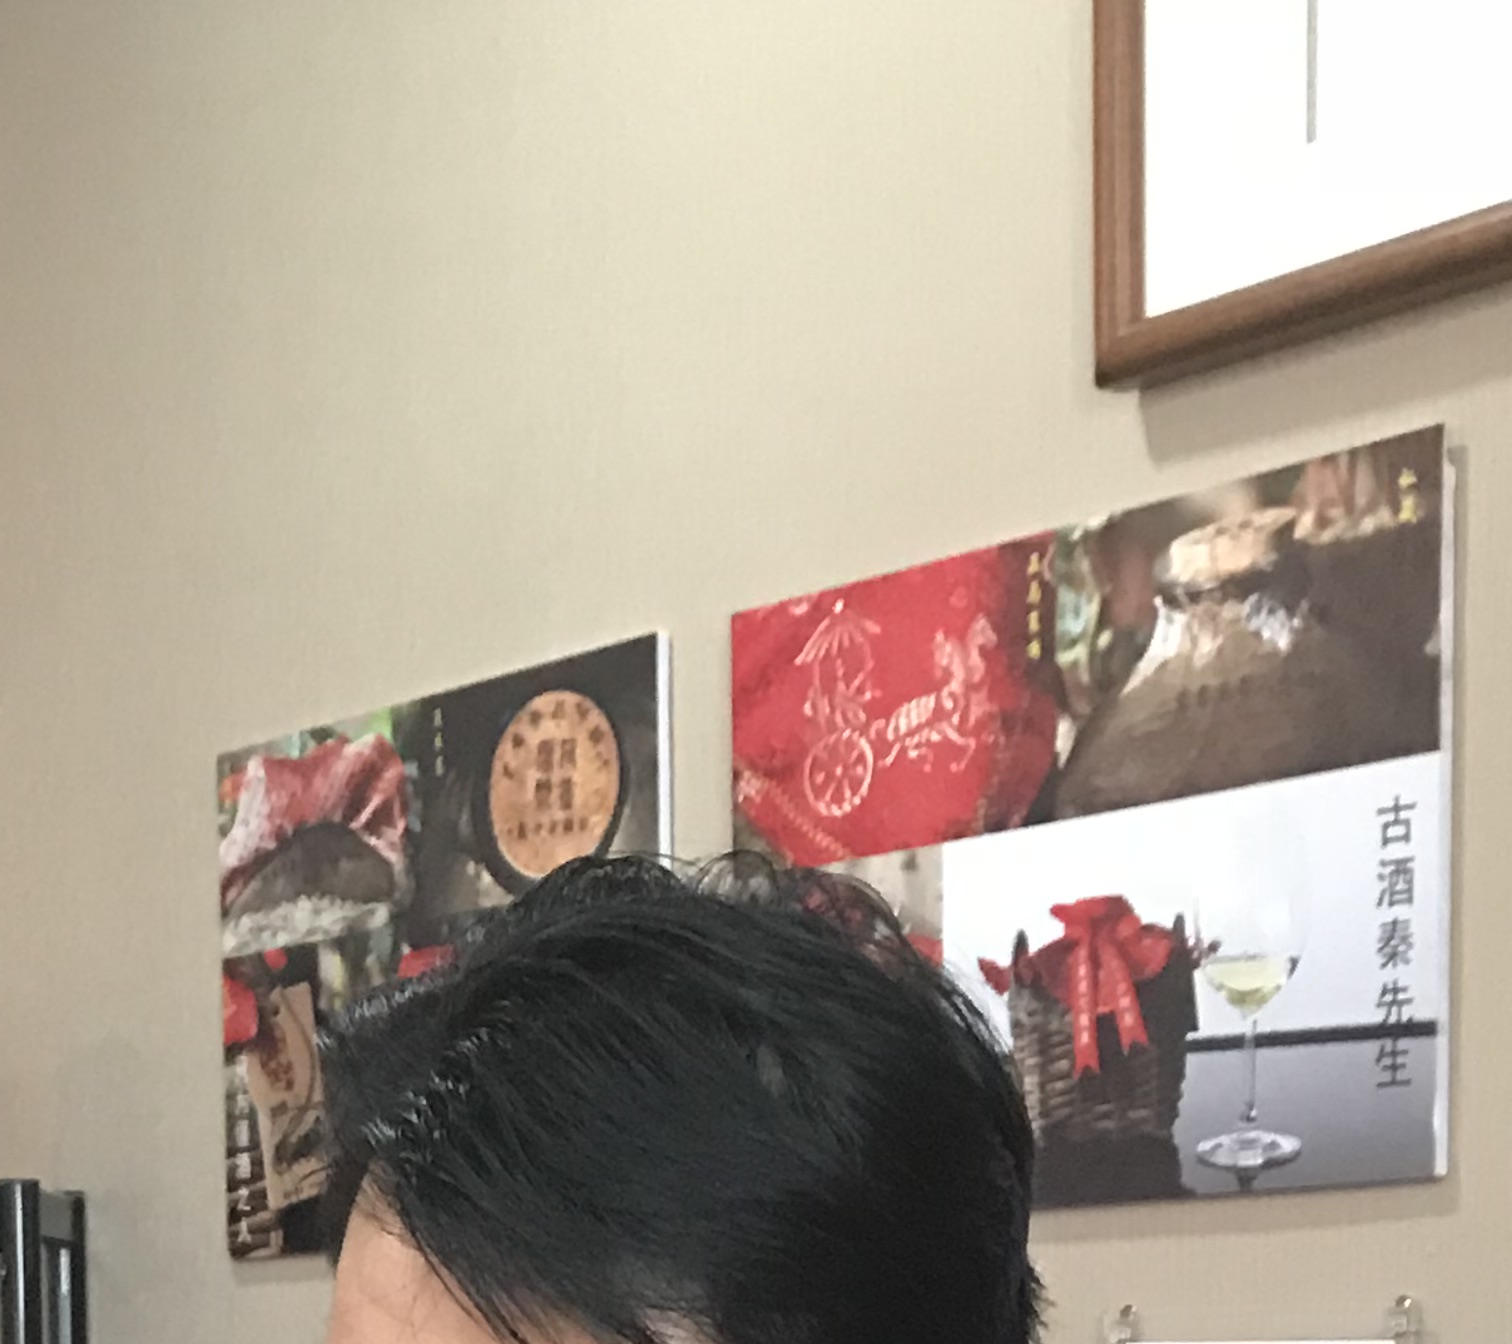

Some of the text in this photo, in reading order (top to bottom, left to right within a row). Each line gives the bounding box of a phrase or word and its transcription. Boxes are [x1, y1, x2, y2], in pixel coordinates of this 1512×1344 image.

[1375, 794, 1417, 1089] 古酒秦先生
